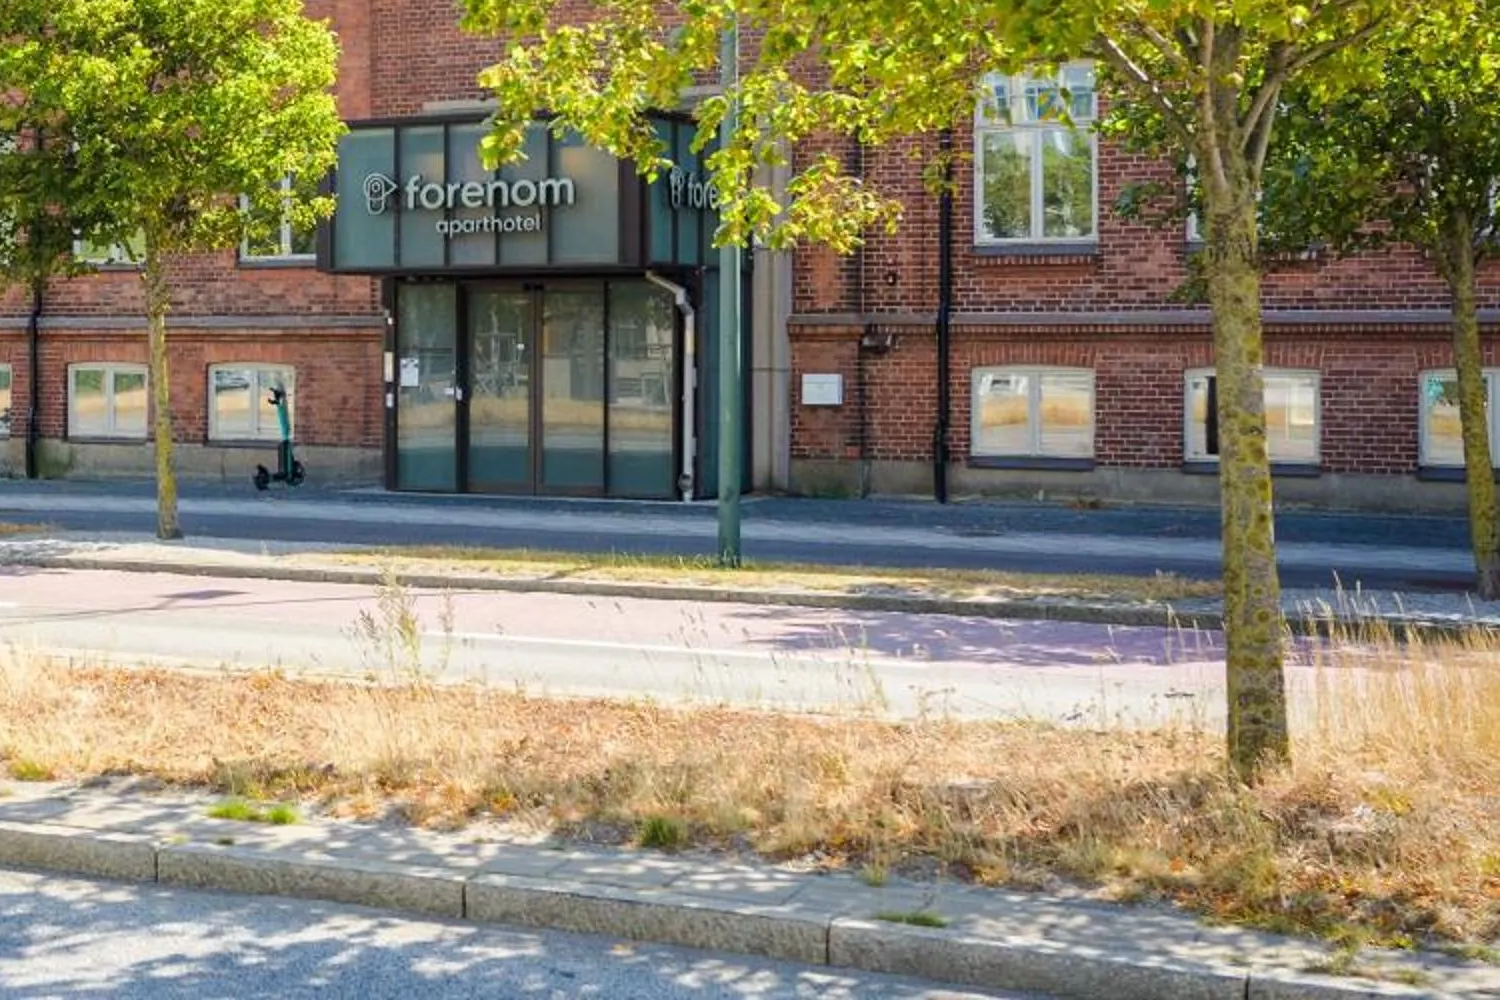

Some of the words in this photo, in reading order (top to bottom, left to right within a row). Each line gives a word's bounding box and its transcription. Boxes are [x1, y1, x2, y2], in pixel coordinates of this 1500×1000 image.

[405, 174, 575, 209] forenom
[687, 172, 719, 210] fore
[435, 213, 541, 239] aparthotel
